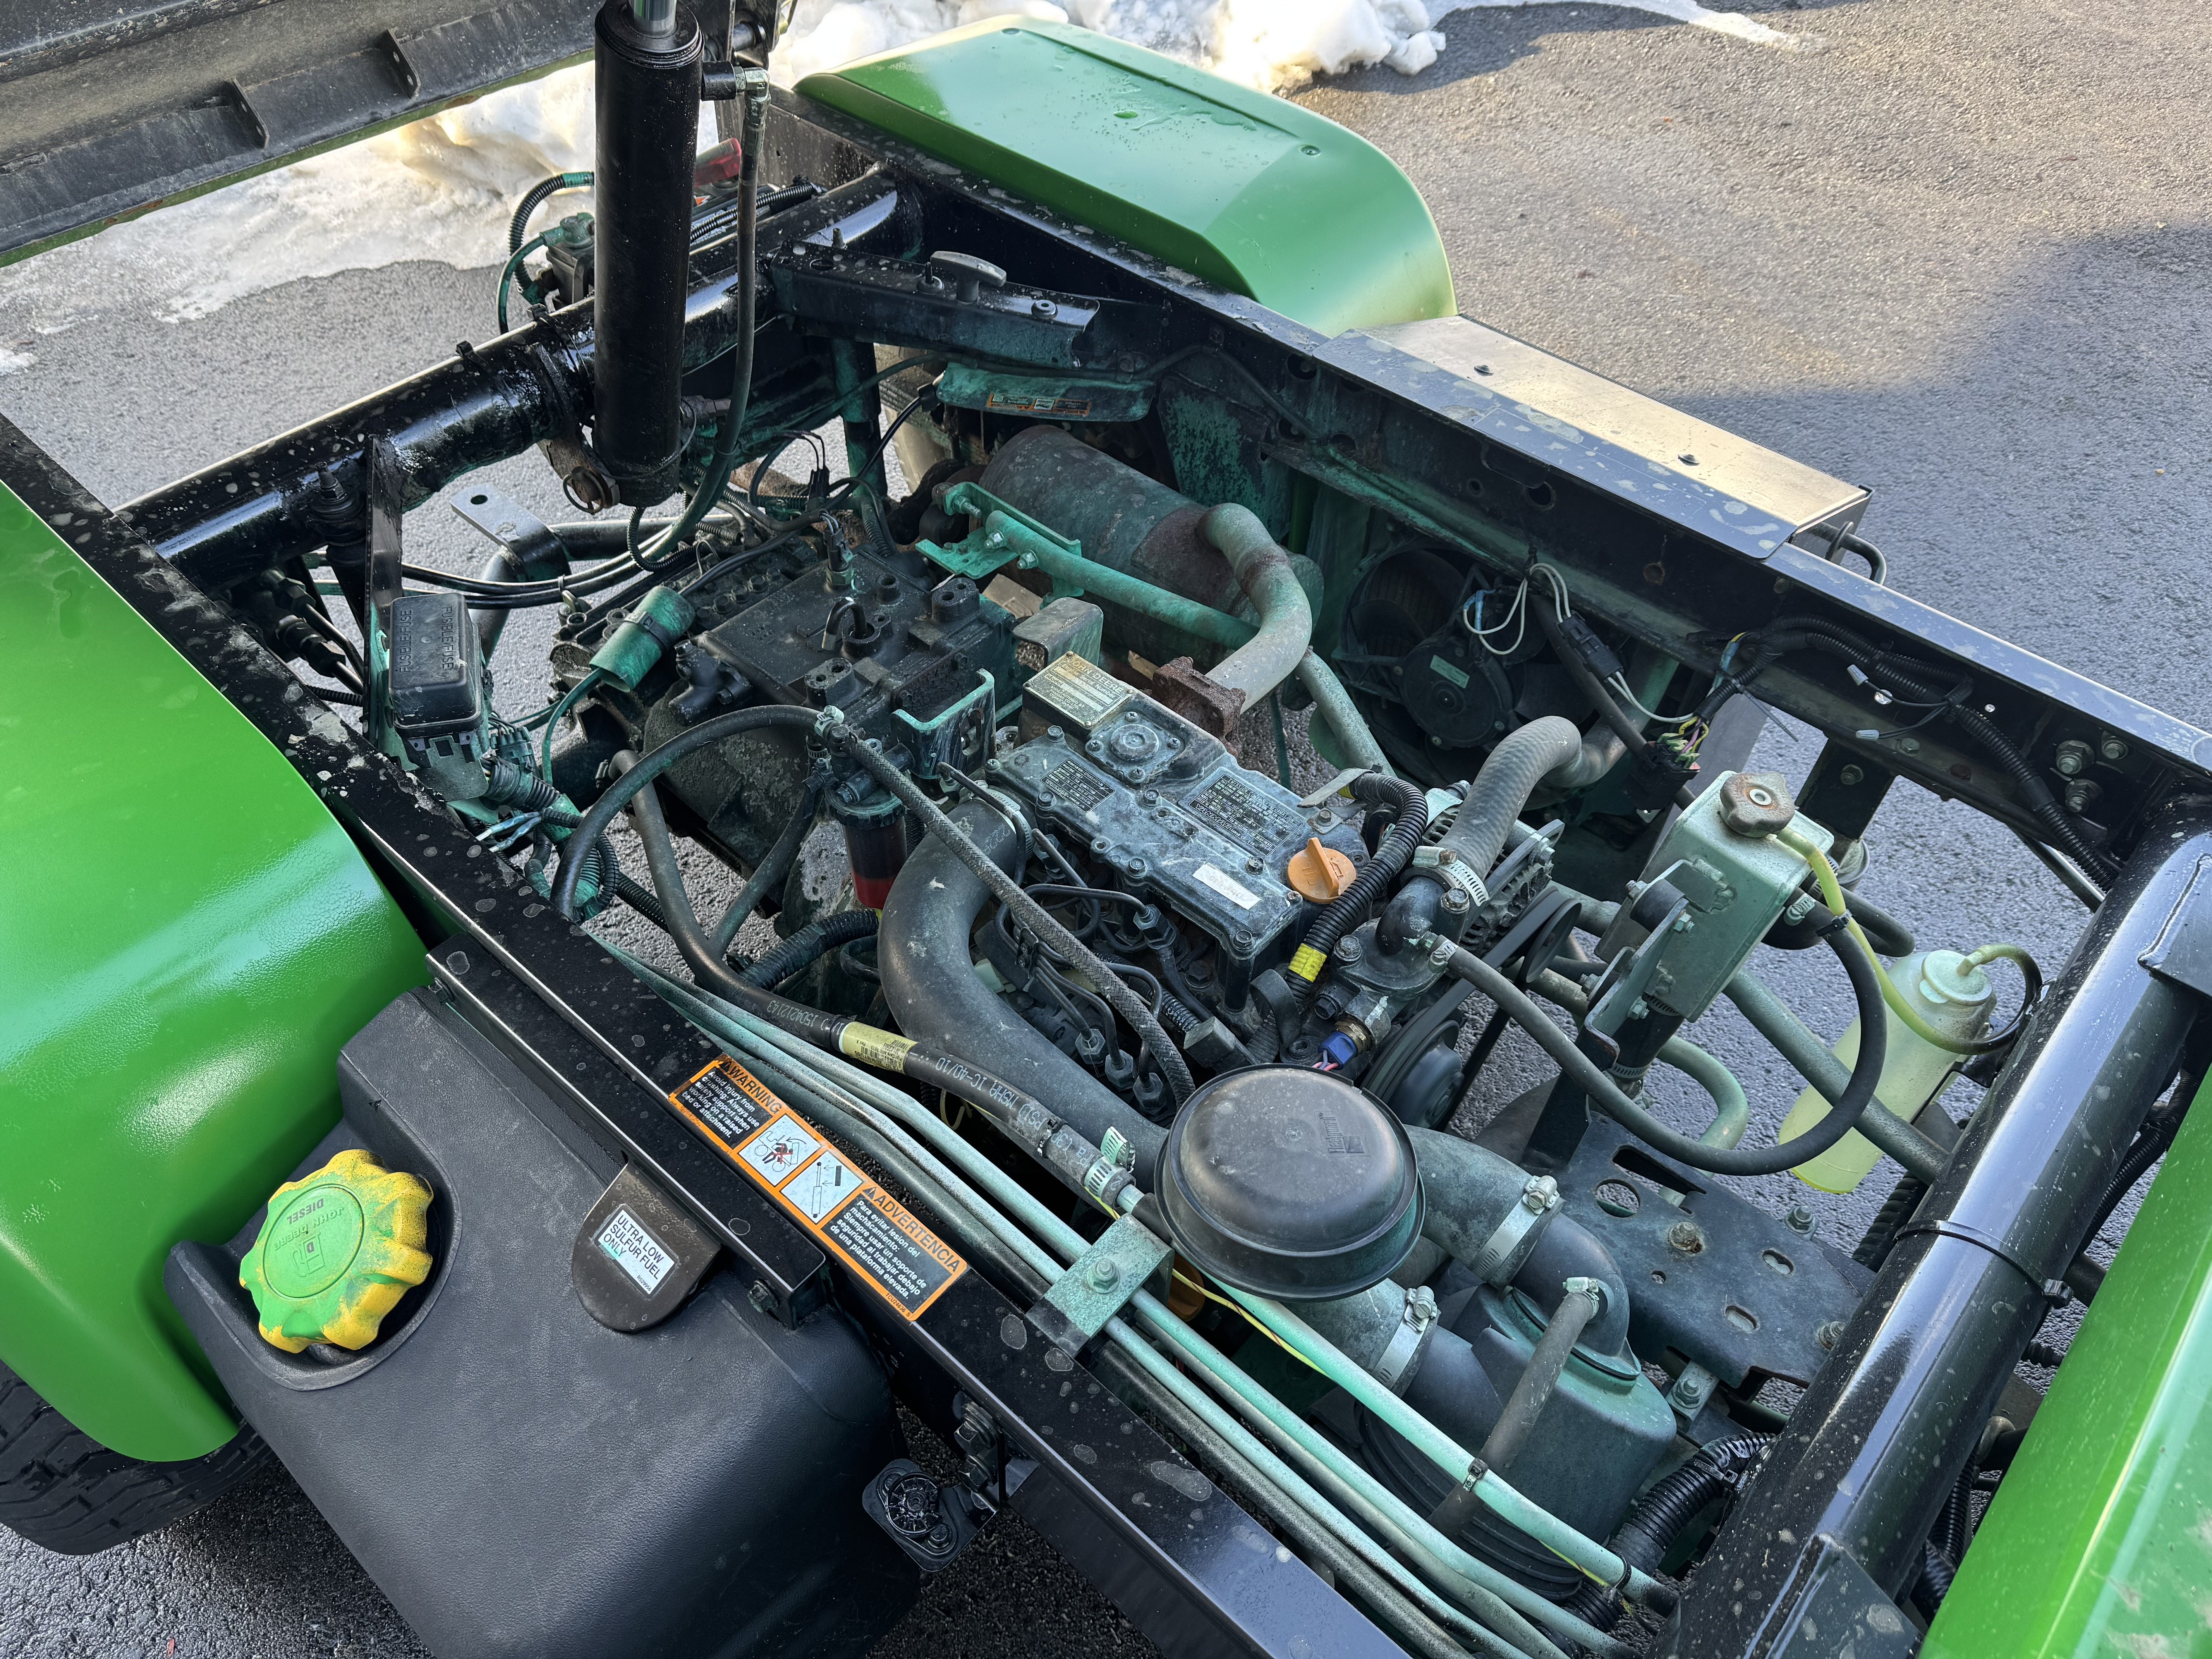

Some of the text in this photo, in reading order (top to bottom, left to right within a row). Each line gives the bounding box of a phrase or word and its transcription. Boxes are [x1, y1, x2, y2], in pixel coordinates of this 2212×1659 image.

[399, 609, 412, 672] FUSIBLE/FUSE
[441, 606, 453, 669] FUSIBLE/FUSE
[1046, 673, 1063, 686] Model
[1079, 674, 1095, 685] Serial
[1094, 684, 1115, 699] Number
[1092, 673, 1124, 694] DEERE
[1195, 803, 1232, 830] YANMAR
[1250, 793, 1266, 804] CONTROL
[766, 999, 819, 1027] 1504212143
[708, 1072, 756, 1113] Avoid injury from
[730, 1067, 782, 1114] WARNING
[934, 1056, 987, 1091] IC-40/10
[987, 1082, 1019, 1109] MSHA
[682, 1091, 696, 1103] bed
[699, 1107, 732, 1138] attachment.
[689, 1086, 711, 1108] working
[710, 1106, 719, 1115] on
[722, 1117, 743, 1135] raised
[695, 1081, 750, 1131] safety support when
[701, 1076, 759, 1128] crushing: Always use
[275, 1207, 343, 1250] JOHN DEERE
[286, 1197, 324, 1224] DIESEL
[849, 1206, 900, 1252] machacamiento:
[856, 1200, 921, 1258] Para evitar lesion del
[306, 1241, 315, 1254] D
[603, 1233, 627, 1257] ONLY
[609, 1223, 660, 1280] SULFUR FUEL
[617, 1214, 664, 1263] ULTRA LOW
[836, 1219, 921, 1295] seguridad al trabajar debajo
[843, 1212, 927, 1289] Siempre usar un soporte de
[873, 1195, 960, 1273] ADVERTENCIA
[636, 1275, 652, 1291] R529956
[830, 1225, 910, 1299] de una plataforma elevada.
